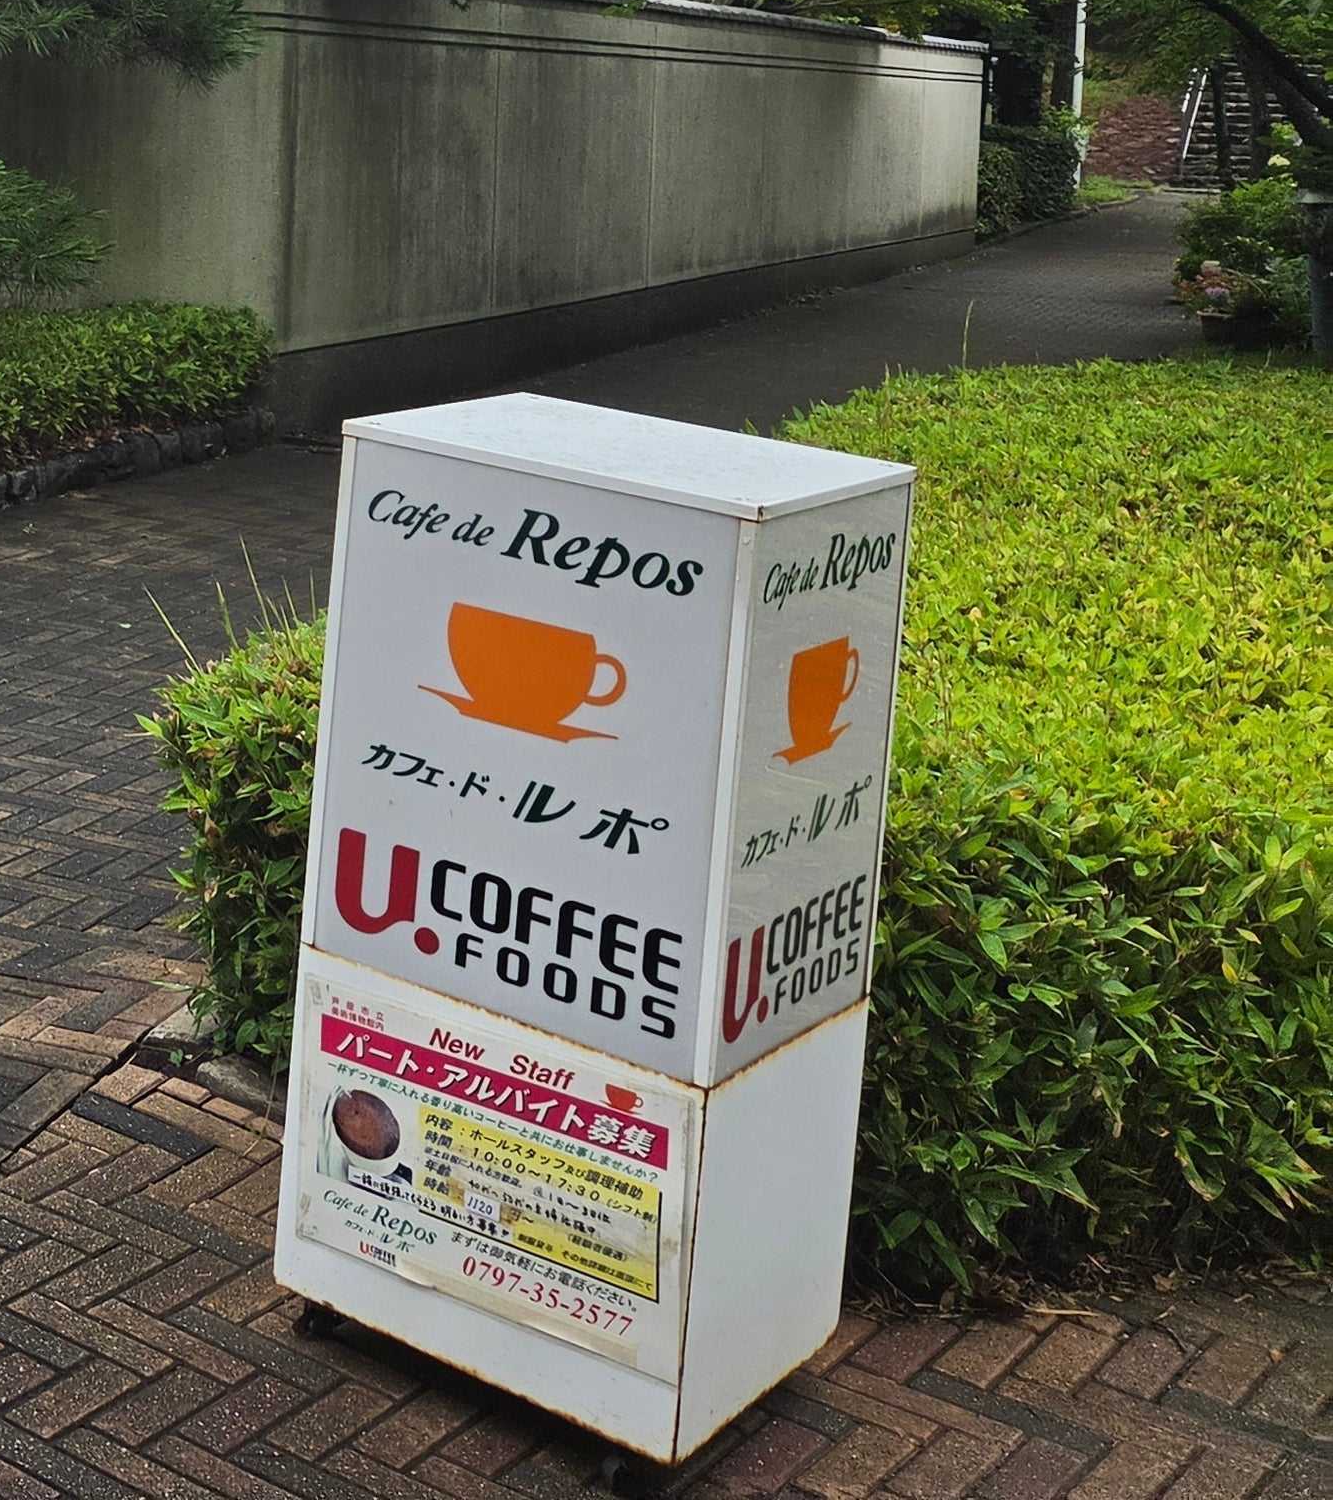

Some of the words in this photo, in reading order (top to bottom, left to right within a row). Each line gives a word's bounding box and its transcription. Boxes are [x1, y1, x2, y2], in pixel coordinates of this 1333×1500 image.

[368, 489, 451, 540] Cafe
[451, 513, 495, 546] de
[500, 508, 704, 596] Repos
[763, 561, 801, 611] Cafe
[799, 556, 819, 593] de
[819, 532, 896, 591] Repos
[430, 859, 683, 995] COFFEE
[766, 874, 867, 975] COFFEE
[454, 932, 676, 1040] FOODS
[773, 937, 860, 1015] FOODS
[336, 1032, 656, 1159] パート・アルバイト募集
[429, 1027, 485, 1061] New
[509, 1054, 575, 1090] Staff
[323, 1189, 353, 1211] Cafe
[353, 1204, 369, 1217] de
[371, 1204, 438, 1245] Repos
[461, 1256, 634, 1336] 0797-35-2577
